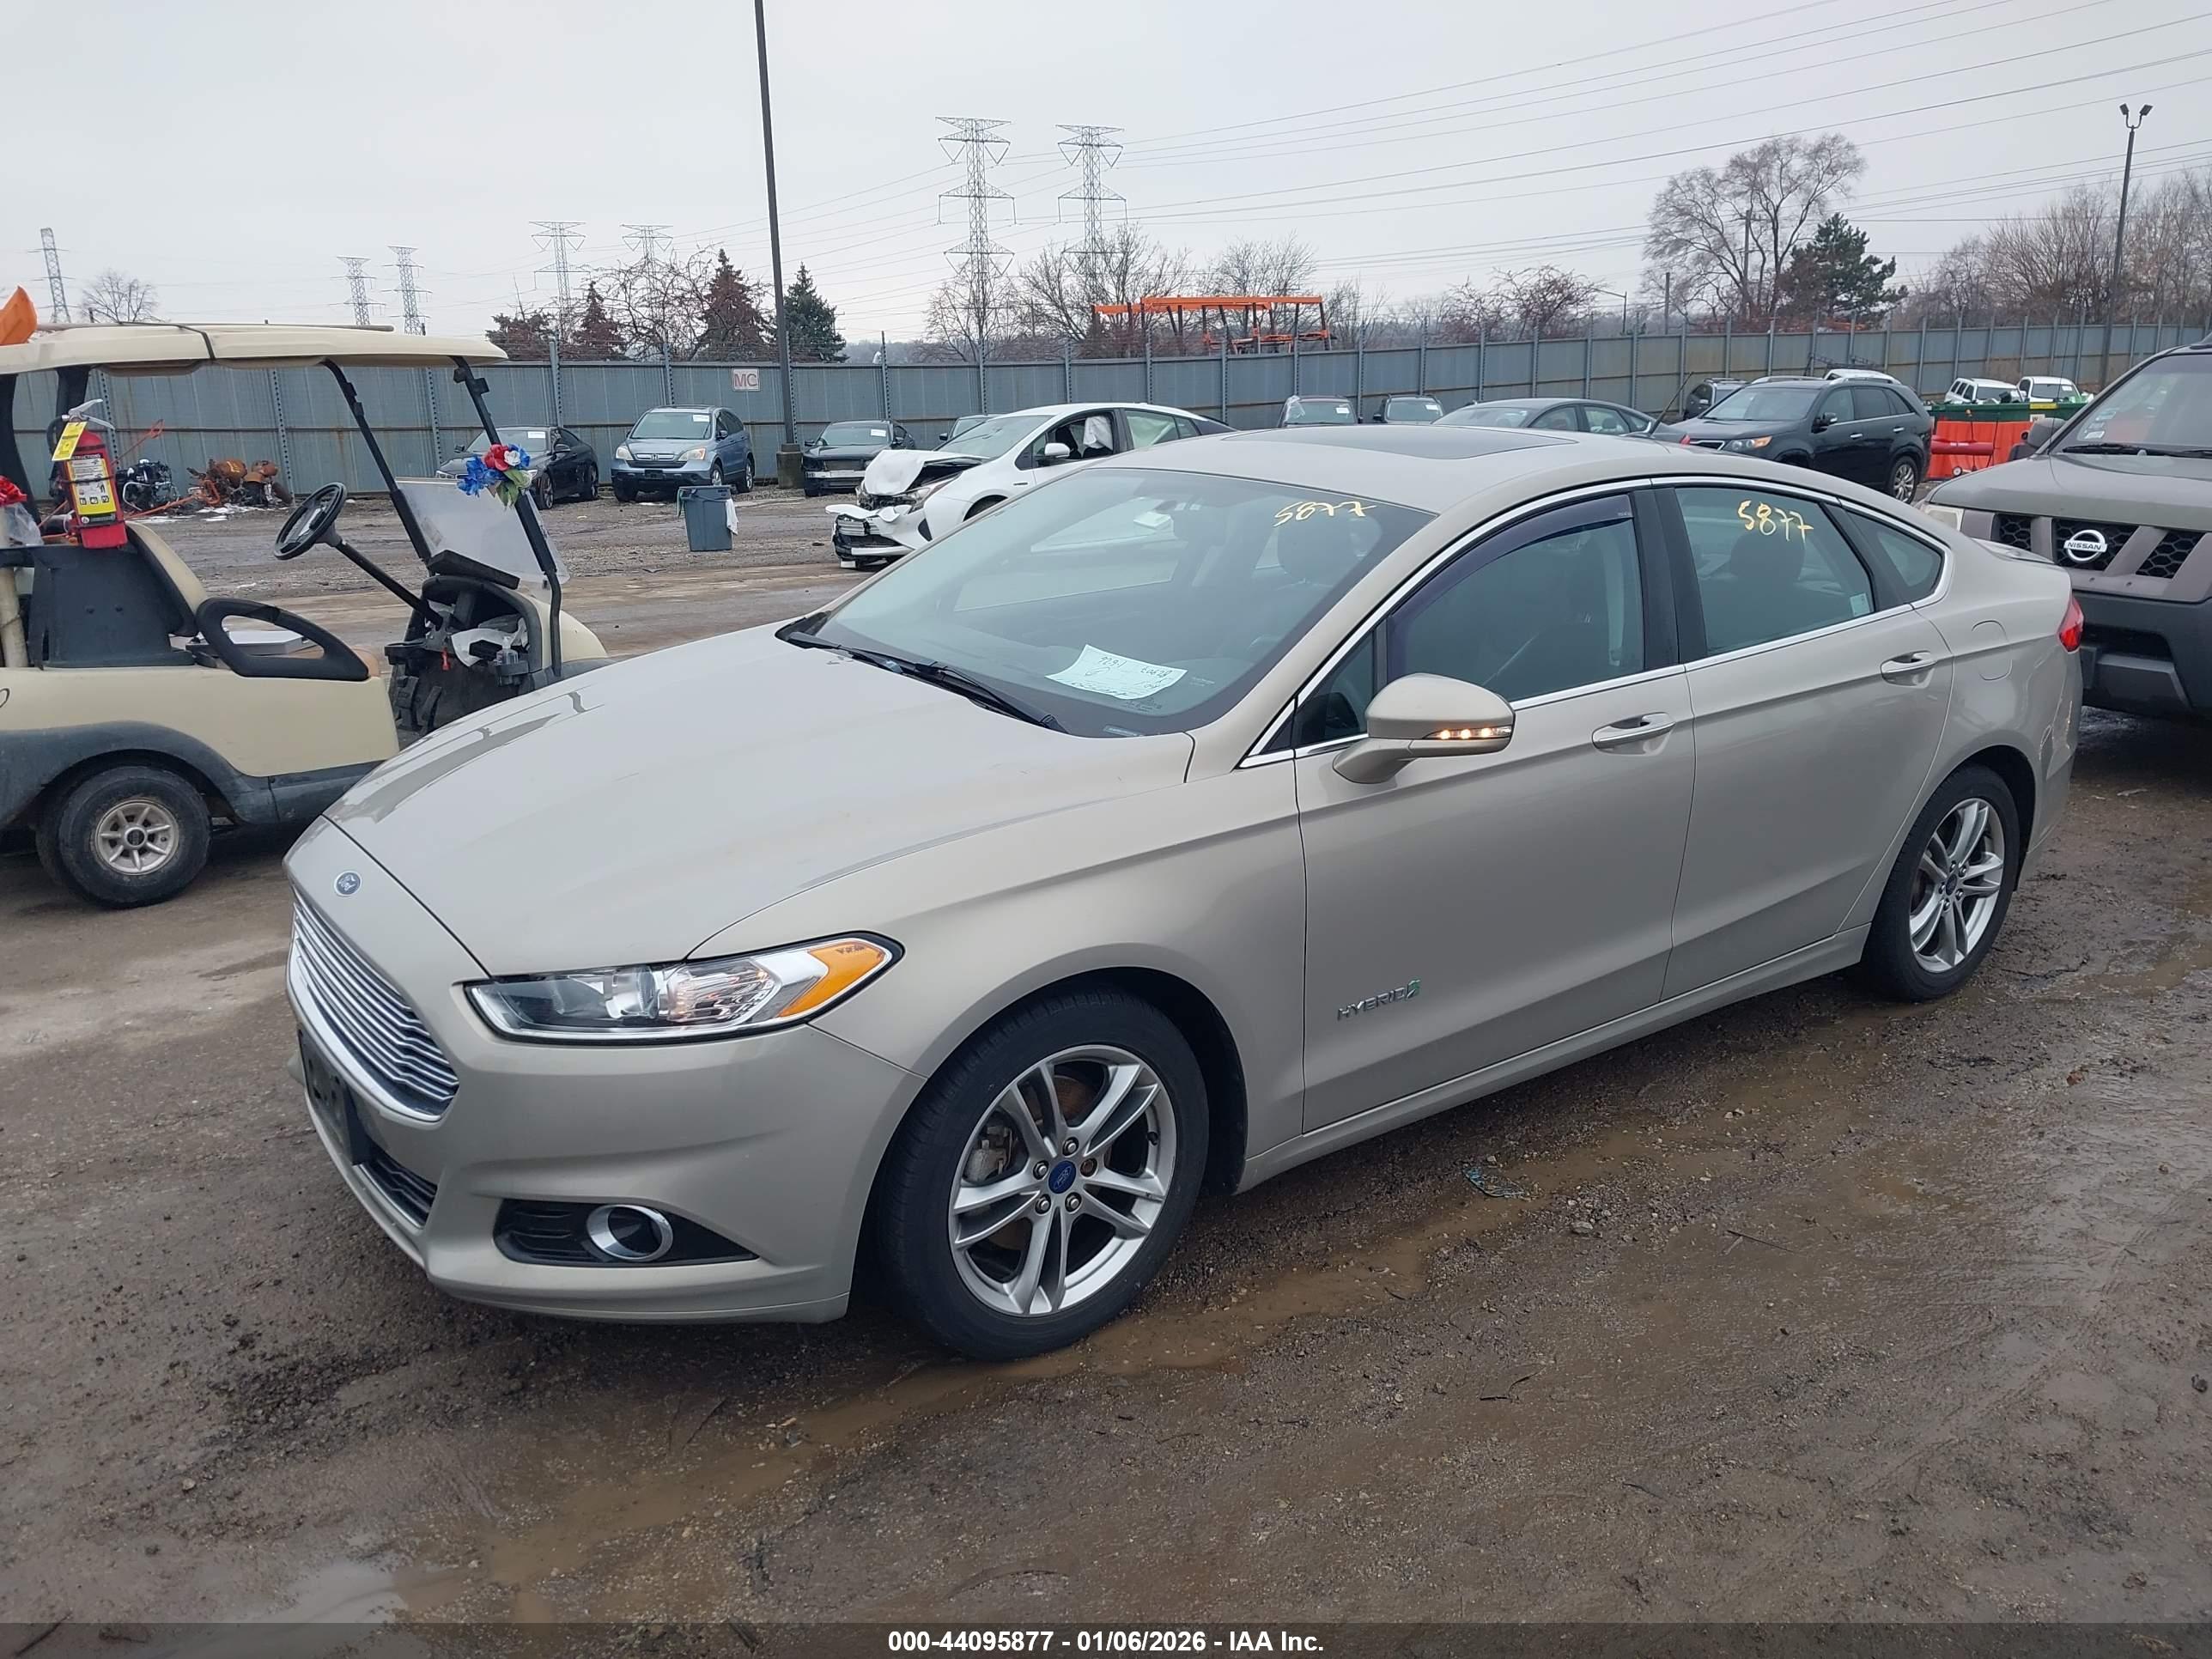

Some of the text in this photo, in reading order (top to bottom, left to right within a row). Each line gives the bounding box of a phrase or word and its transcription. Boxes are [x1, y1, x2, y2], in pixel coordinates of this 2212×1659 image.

[734, 373, 757, 387] MC
[1273, 501, 1377, 527] 5877
[1737, 500, 1814, 544] 5877
[2067, 541, 2102, 550] NISSAN
[1337, 987, 1406, 1021] HYBRID
